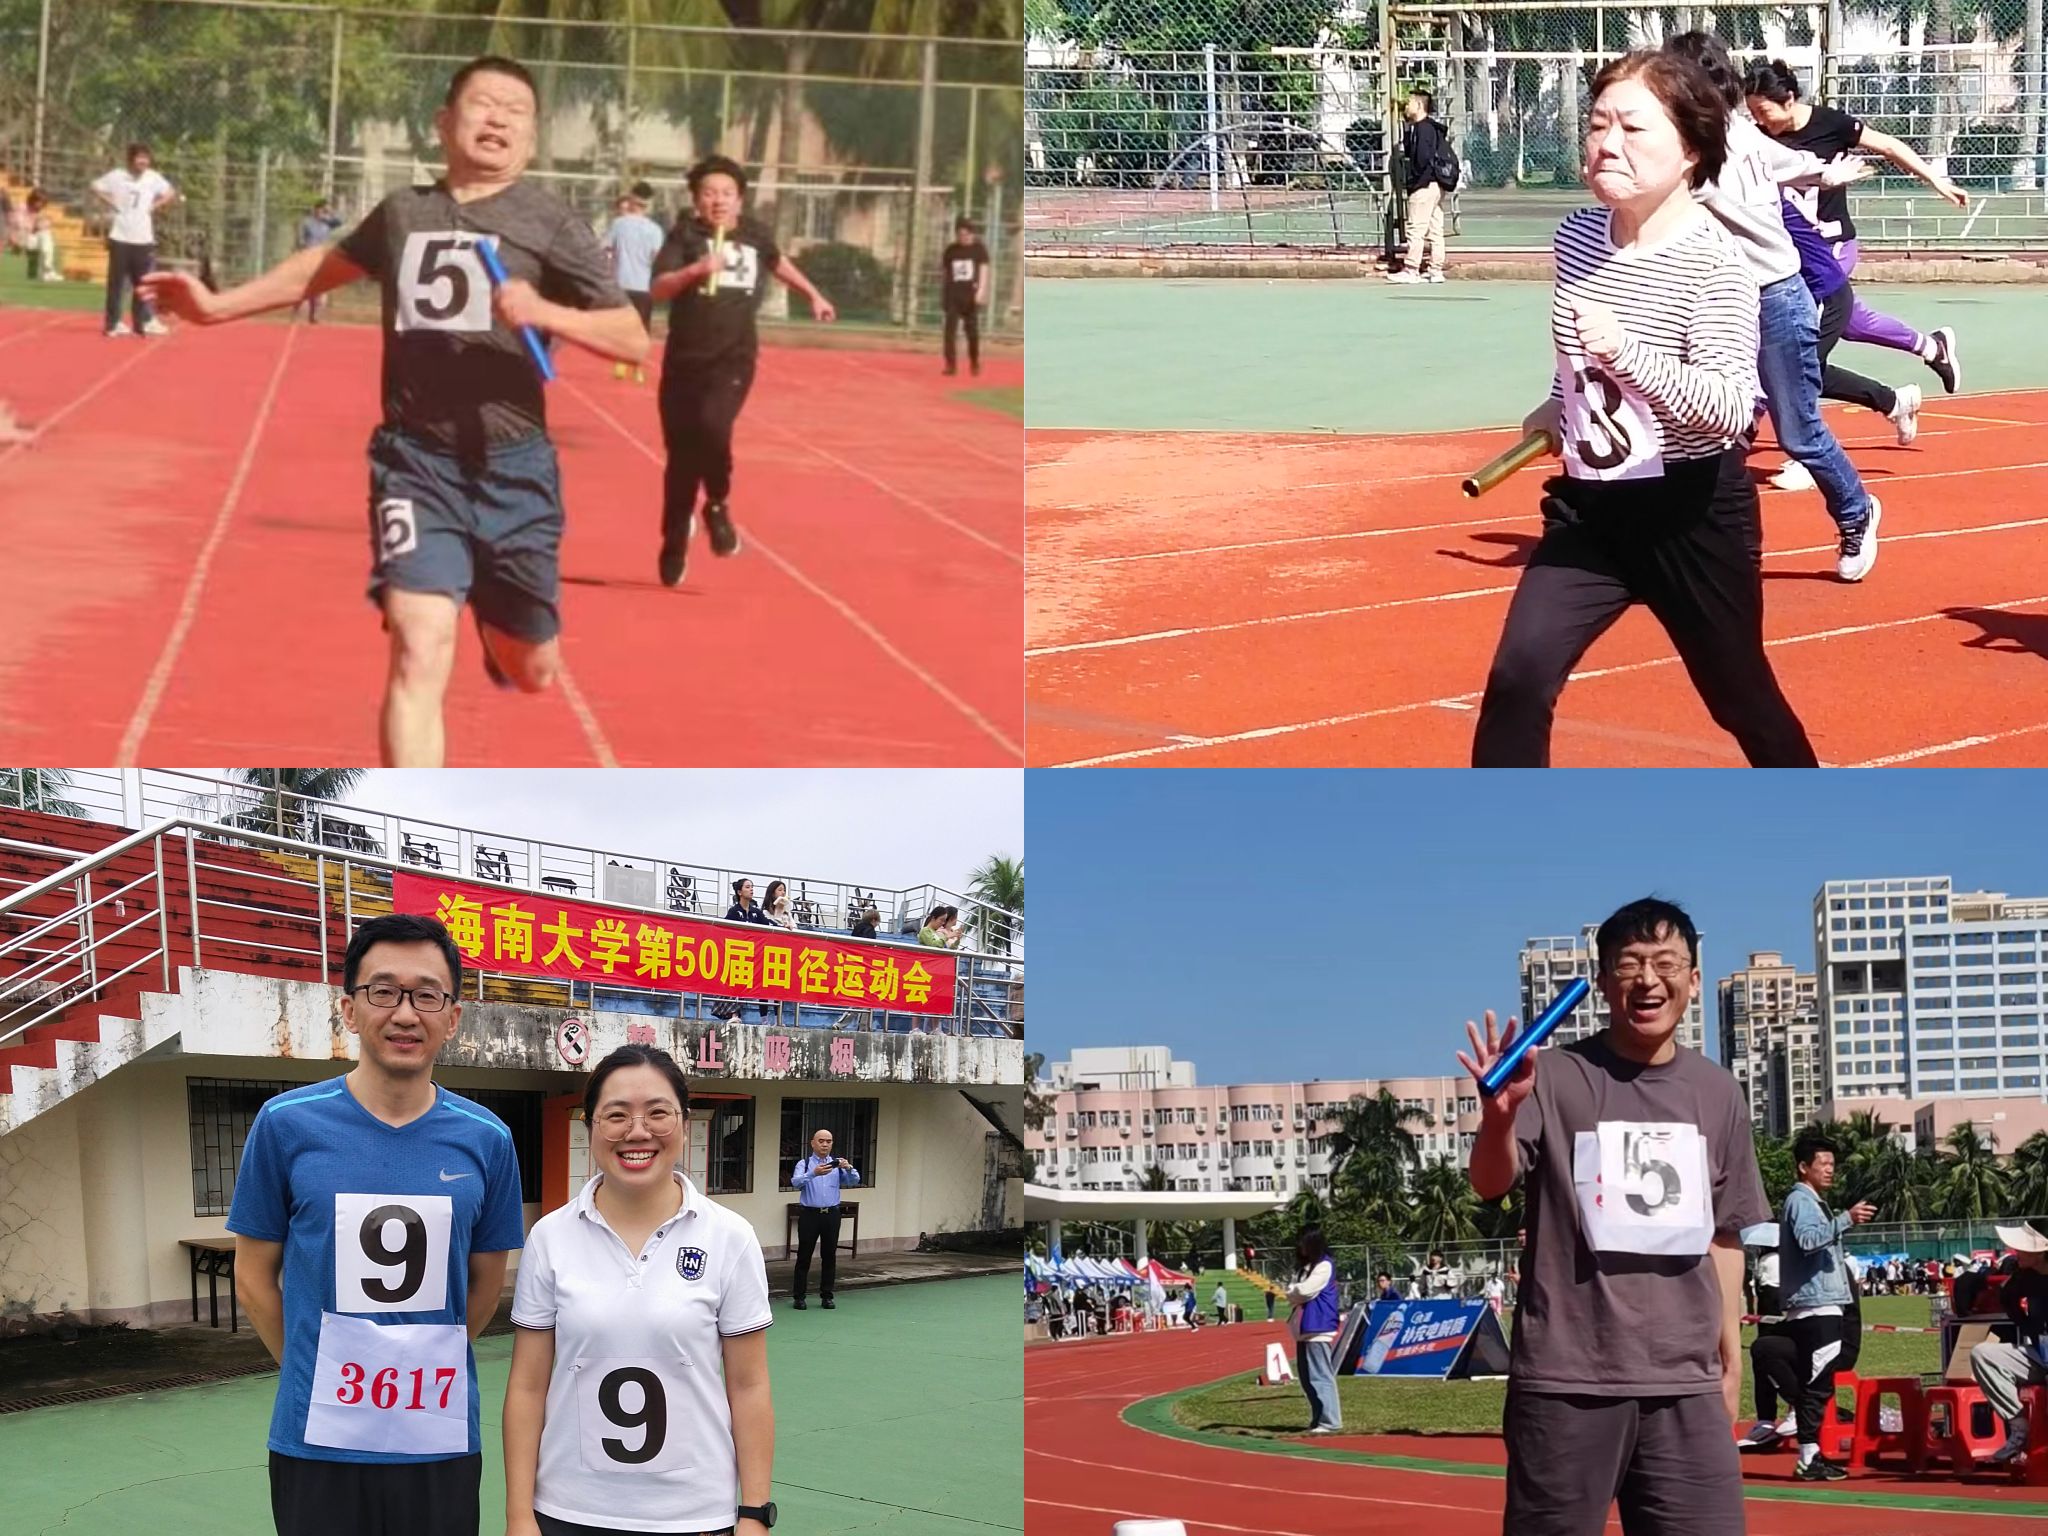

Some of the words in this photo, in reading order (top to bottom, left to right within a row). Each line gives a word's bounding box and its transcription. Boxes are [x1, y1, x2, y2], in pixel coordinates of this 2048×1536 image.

[129, 191, 141, 209] 7
[415, 239, 471, 321] 5
[1574, 366, 1632, 470] 3
[381, 504, 411, 551] 5
[435, 892, 933, 1005] 海南大学第50届田径运动会
[1623, 1131, 1682, 1217] 5
[359, 1204, 428, 1304] 9
[336, 1362, 457, 1410] 3617
[1272, 1353, 1282, 1374] 1
[598, 1367, 667, 1464] 9
